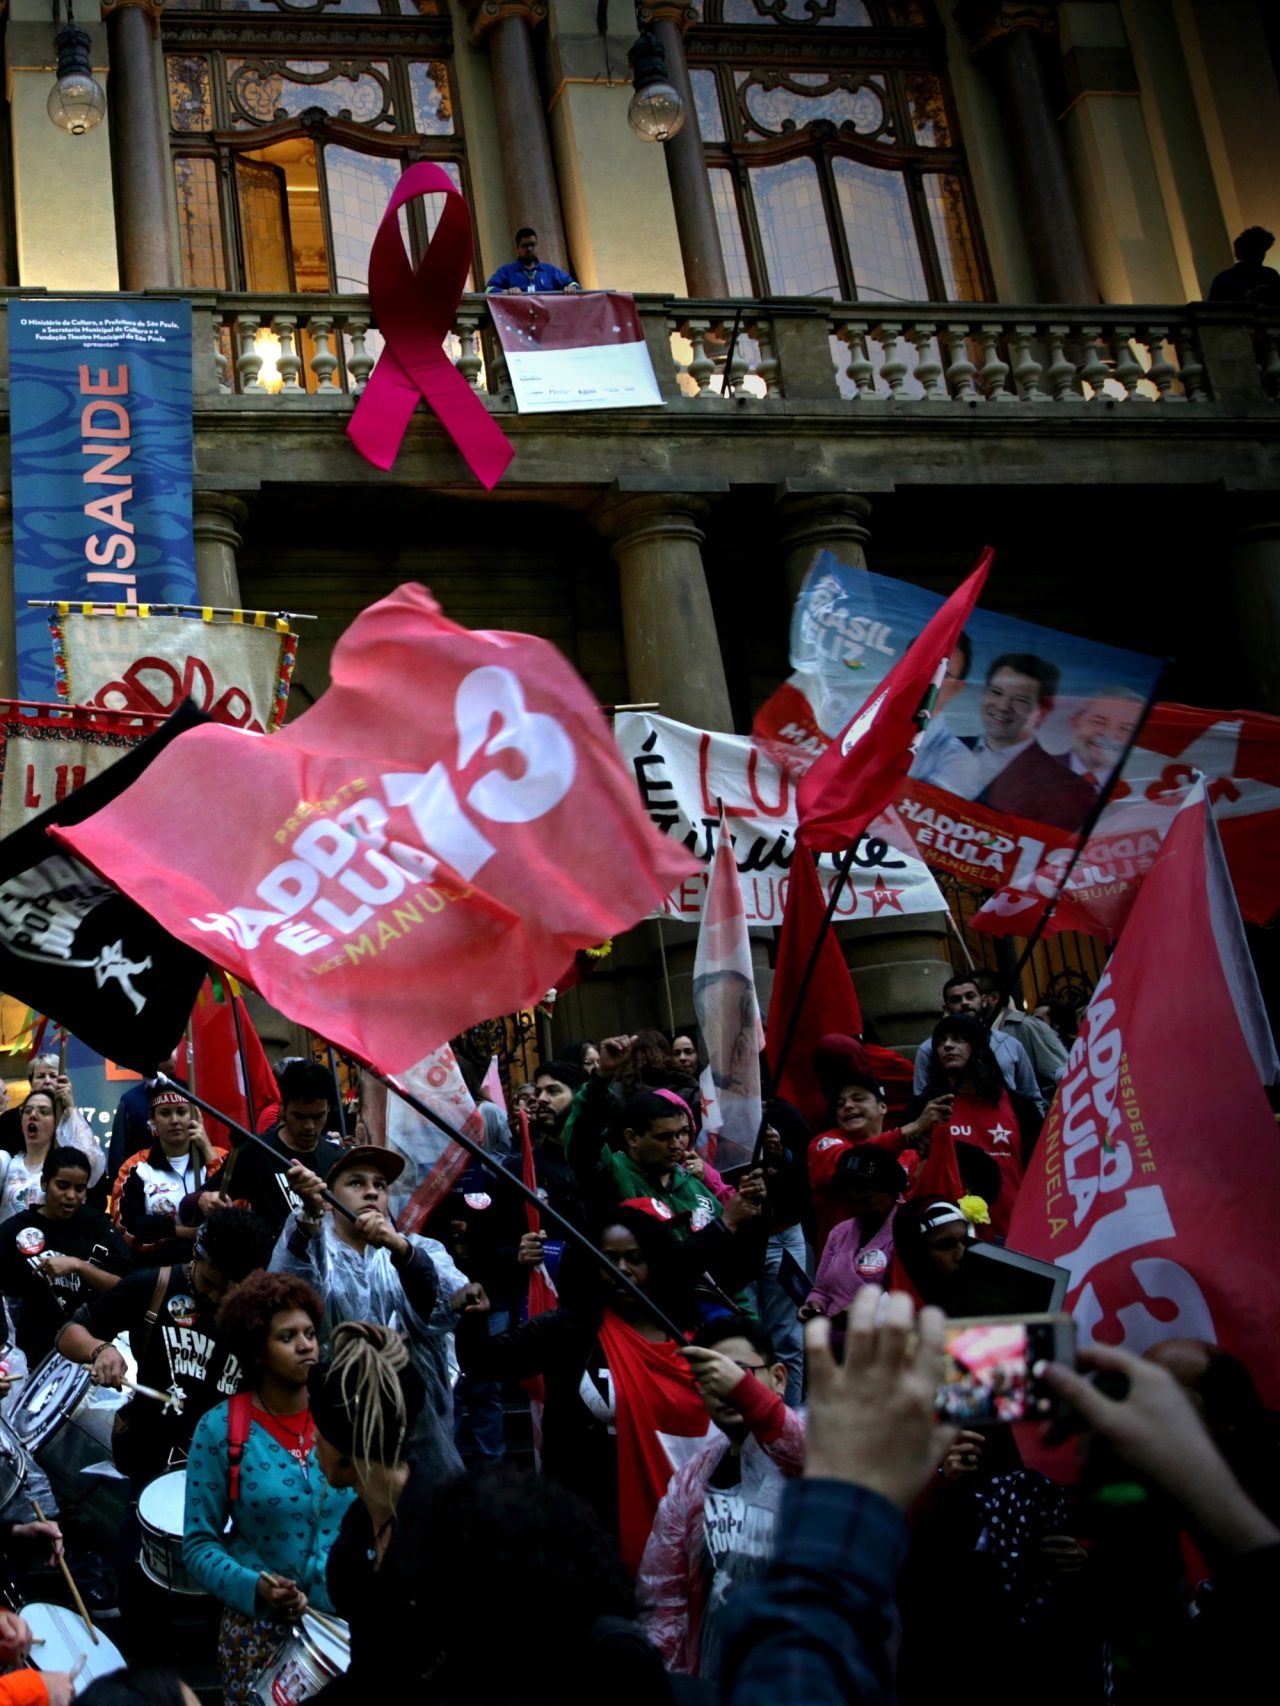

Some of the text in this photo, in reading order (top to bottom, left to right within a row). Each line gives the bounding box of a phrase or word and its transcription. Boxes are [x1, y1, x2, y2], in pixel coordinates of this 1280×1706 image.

[35, 333, 67, 341] Fundação
[93, 333, 125, 341] Municipal
[135, 334, 146, 342] São
[148, 335, 166, 343] Paulo
[104, 319, 136, 327] Prefeitura
[78, 363, 140, 617] LISANDE
[380, 665, 578, 881] 13
[633, 730, 678, 810] É
[699, 732, 790, 818] LU
[898, 798, 1018, 854] HADDAD
[935, 835, 1005, 873] LULA
[871, 888, 895, 903] PT
[1060, 1066, 1101, 1229] LULA
[1120, 1051, 1157, 1174] PRESIDENTE
